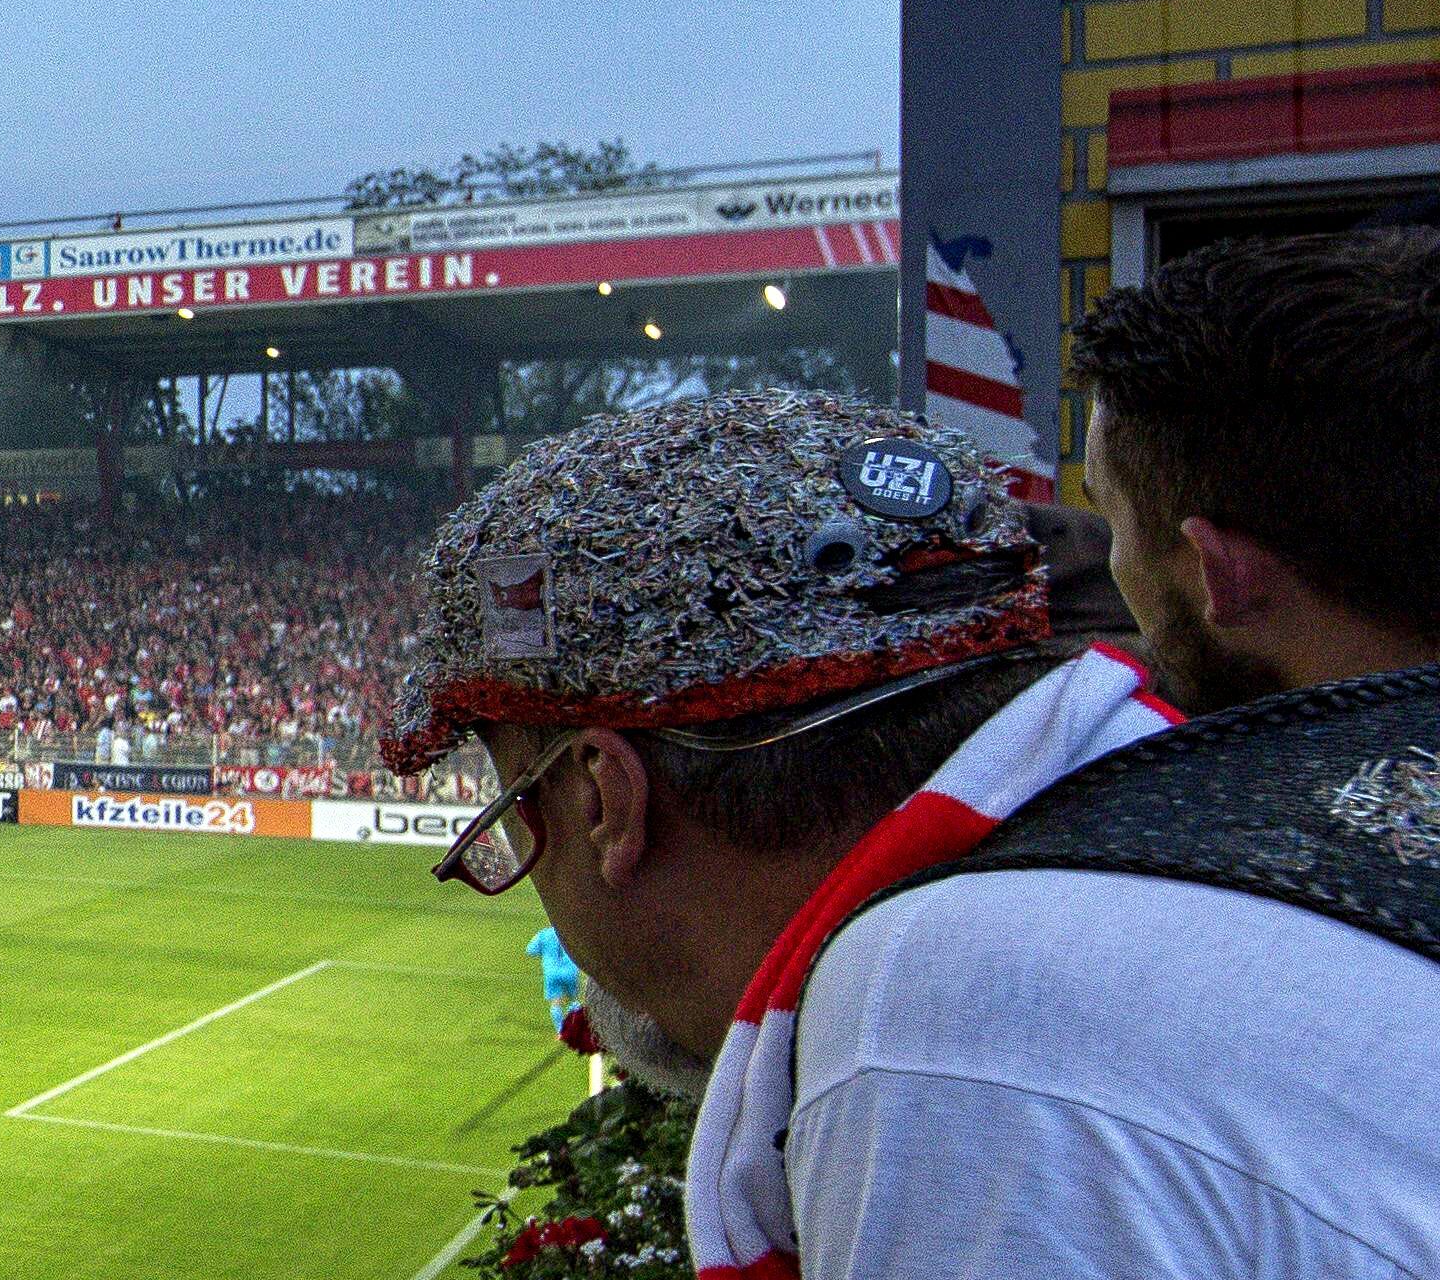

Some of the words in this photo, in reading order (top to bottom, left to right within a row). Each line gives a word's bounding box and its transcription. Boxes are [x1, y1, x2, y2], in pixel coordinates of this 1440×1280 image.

[765, 190, 899, 215] Wernec
[60, 229, 341, 269] SaarowTherme.de
[93, 270, 250, 308] UNSER
[281, 254, 499, 296] VEREIN.
[859, 451, 936, 497] UZI
[872, 488, 912, 502] DOES
[915, 494, 932, 505] IT
[76, 798, 249, 828] kfzteile24
